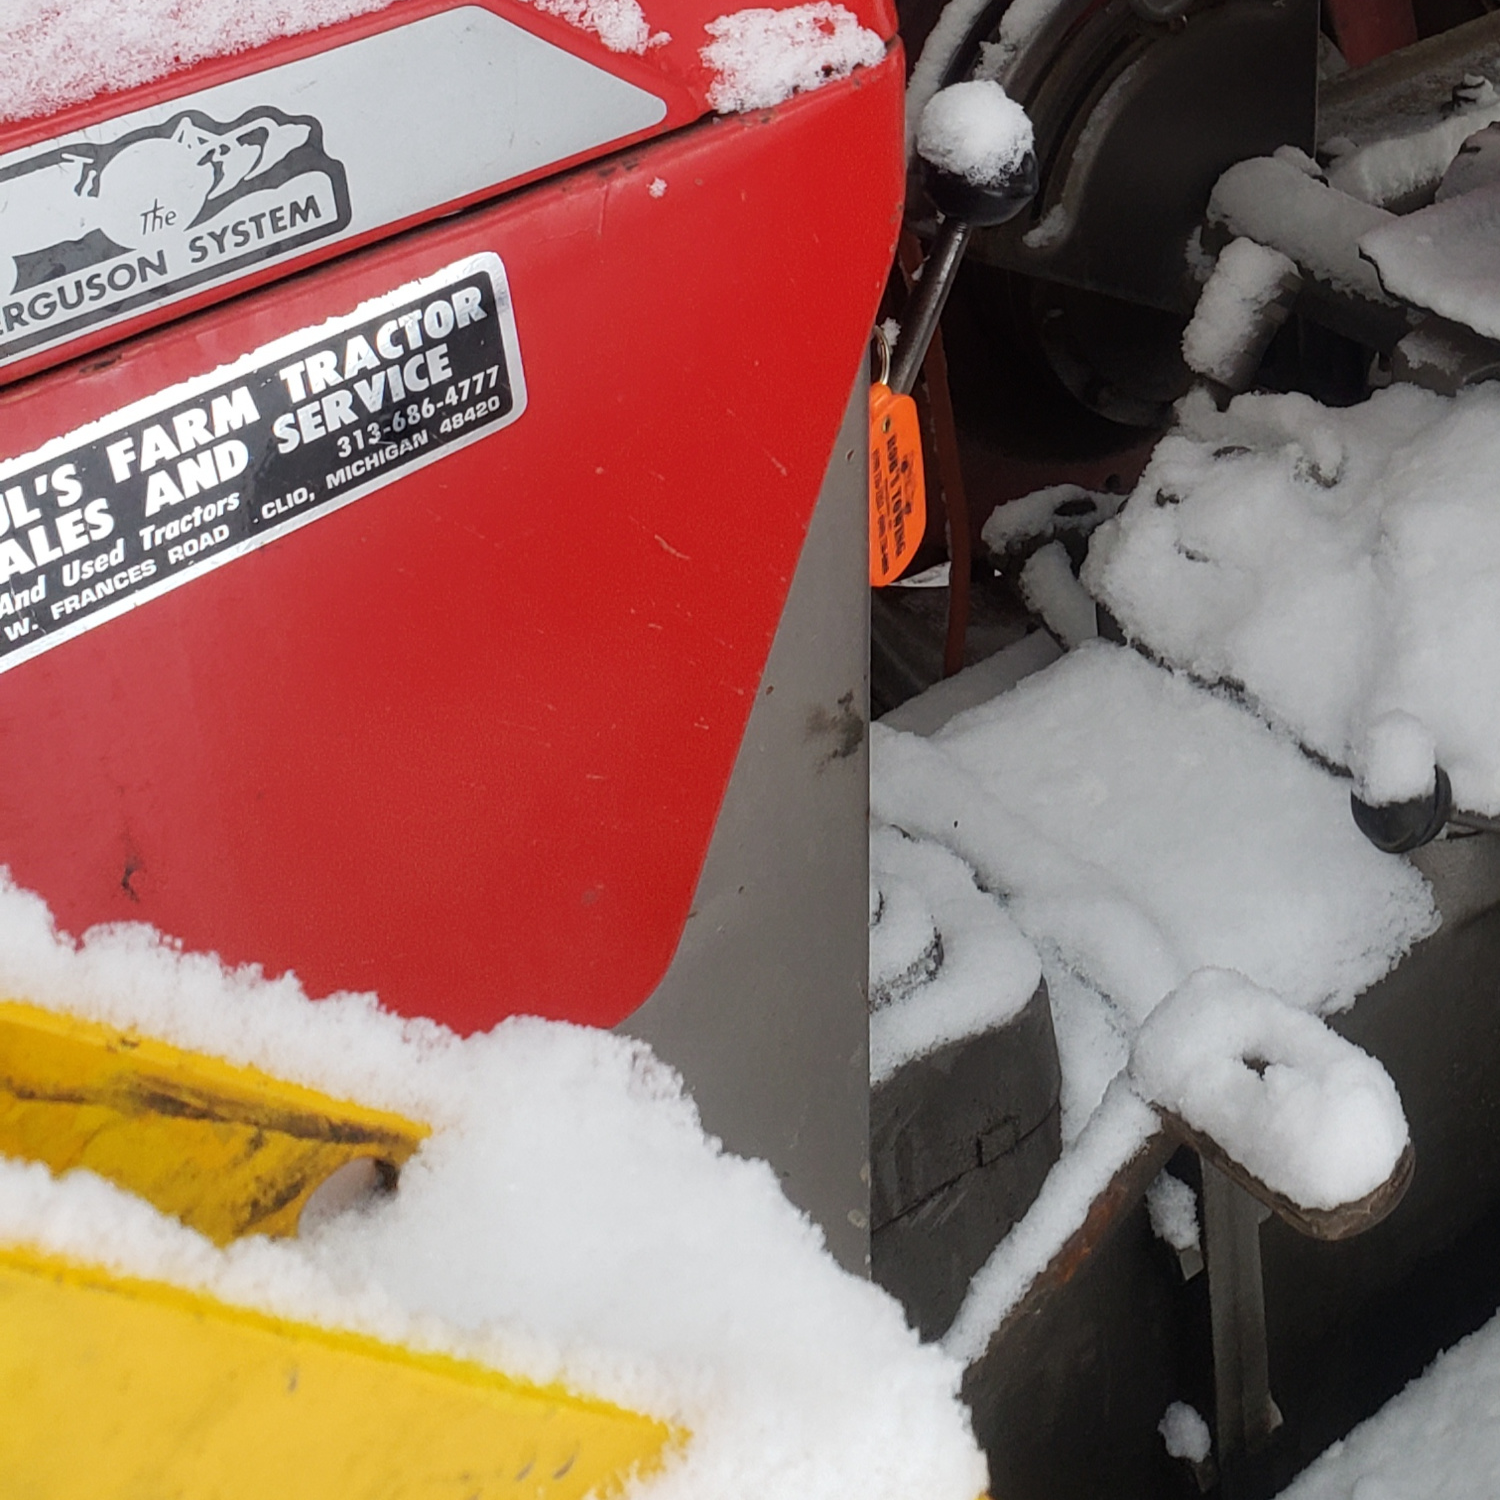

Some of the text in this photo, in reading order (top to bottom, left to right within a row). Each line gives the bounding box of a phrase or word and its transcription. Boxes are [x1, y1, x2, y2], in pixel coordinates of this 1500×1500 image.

[0, 194, 321, 336] RGUSON SYSTEM
[62, 538, 125, 587] Used
[139, 492, 240, 551] Tractors
[336, 365, 499, 459] 313-686-4777
[106, 385, 261, 484] FARM
[280, 286, 488, 404] TRACTOR
[145, 439, 249, 517] AND
[272, 343, 453, 454] SERVICE
[4, 395, 500, 641] W. FRANCES ROAD CLIO, MICHIGAN 48420
